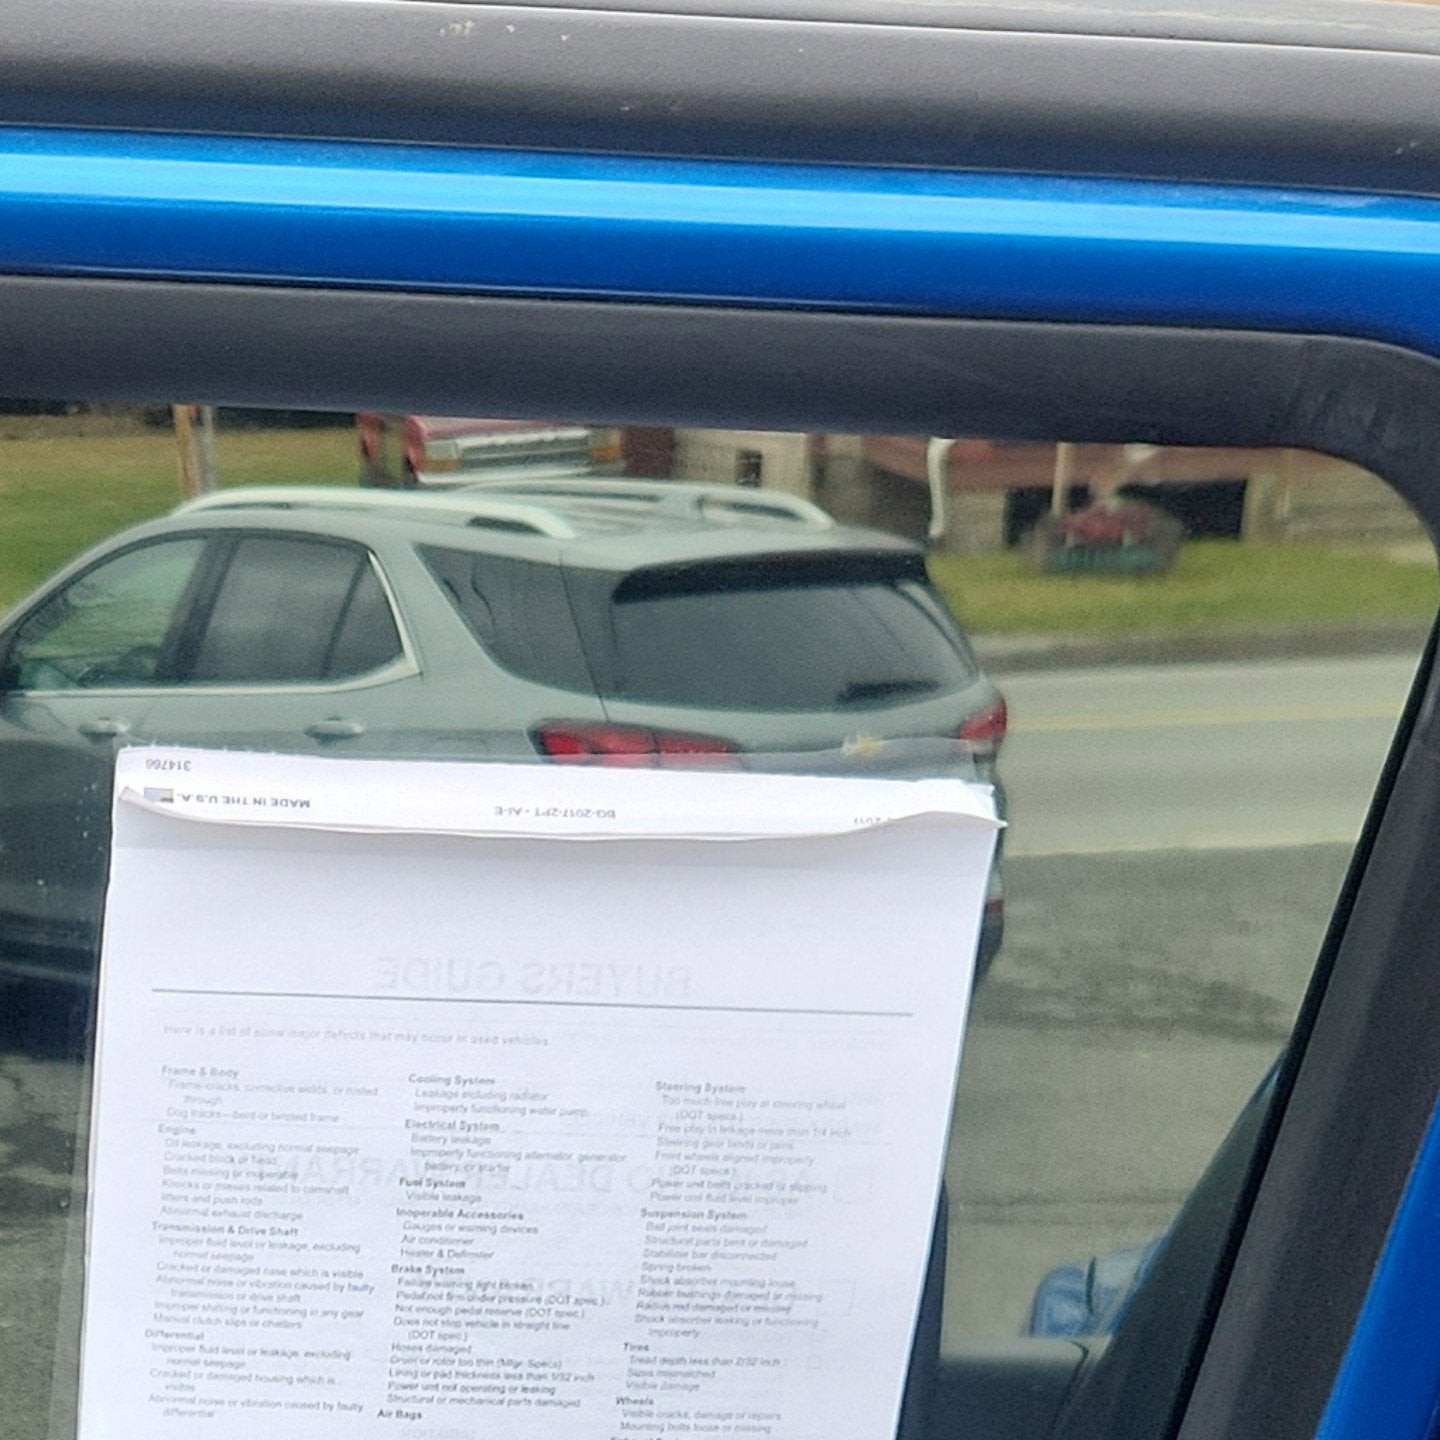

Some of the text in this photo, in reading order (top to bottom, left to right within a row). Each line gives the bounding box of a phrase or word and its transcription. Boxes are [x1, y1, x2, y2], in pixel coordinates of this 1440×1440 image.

[177, 793, 311, 809] MADE IN THE U.S.A.
[160, 1064, 239, 1079] Frame & Body
[407, 1073, 496, 1088] Cooling System
[654, 1080, 746, 1094] Steering System
[157, 1123, 196, 1136] Engine
[404, 1118, 500, 1133] Electrical System
[164, 1136, 179, 1148] Oil
[226, 1140, 276, 1153] excluding
[277, 1142, 313, 1153] normal
[315, 1145, 360, 1156] seepage
[398, 1176, 466, 1190] Fuel System
[405, 1190, 482, 1204] Visible leakage
[395, 1207, 524, 1220] Inoperable Accessories
[640, 1208, 747, 1222] Suspension System
[151, 1221, 298, 1237] Transmission & Drive Shaft
[402, 1221, 442, 1233] Gauges
[457, 1223, 497, 1235] warning
[499, 1224, 539, 1235] devices
[400, 1233, 474, 1245] Air conditioner
[156, 1261, 199, 1272] Cracked
[213, 1263, 261, 1276] damaged
[262, 1267, 287, 1276] case
[289, 1266, 318, 1277] which
[331, 1268, 364, 1279] visible
[390, 1263, 465, 1276] Brake System
[641, 1261, 712, 1273] Spring broken
[155, 1274, 205, 1286] Abnormal
[206, 1276, 234, 1287] noise
[248, 1278, 292, 1289] vibration
[293, 1280, 331, 1291] caused
[332, 1281, 345, 1293] by
[346, 1282, 375, 1294] faulty
[394, 1303, 413, 1313] Not
[414, 1304, 452, 1316] enough
[453, 1305, 482, 1317] pedal
[484, 1308, 522, 1316] reserve
[524, 1306, 552, 1319] (DOT
[152, 1312, 190, 1324] Manual
[192, 1315, 222, 1326] clutch
[224, 1316, 247, 1328] slips
[260, 1318, 302, 1329] chatters
[144, 1328, 204, 1340] Differential
[622, 1341, 649, 1352] Tires
[148, 1367, 191, 1379] Cracked
[205, 1370, 253, 1383] damaged
[253, 1372, 294, 1385] housing
[295, 1374, 325, 1385] which
[164, 1381, 196, 1392] visible
[387, 1381, 419, 1391] Power
[420, 1382, 440, 1392] unit
[440, 1382, 458, 1392] not
[459, 1383, 506, 1395] operating
[520, 1384, 556, 1396] leaking
[625, 1380, 700, 1392] Visible damage
[386, 1393, 435, 1404] Structural
[448, 1395, 505, 1406] mechanical
[506, 1396, 532, 1408] parts
[534, 1397, 581, 1409] damaged
[615, 1396, 654, 1406] Wheels
[376, 1408, 422, 1421] Air Bags
